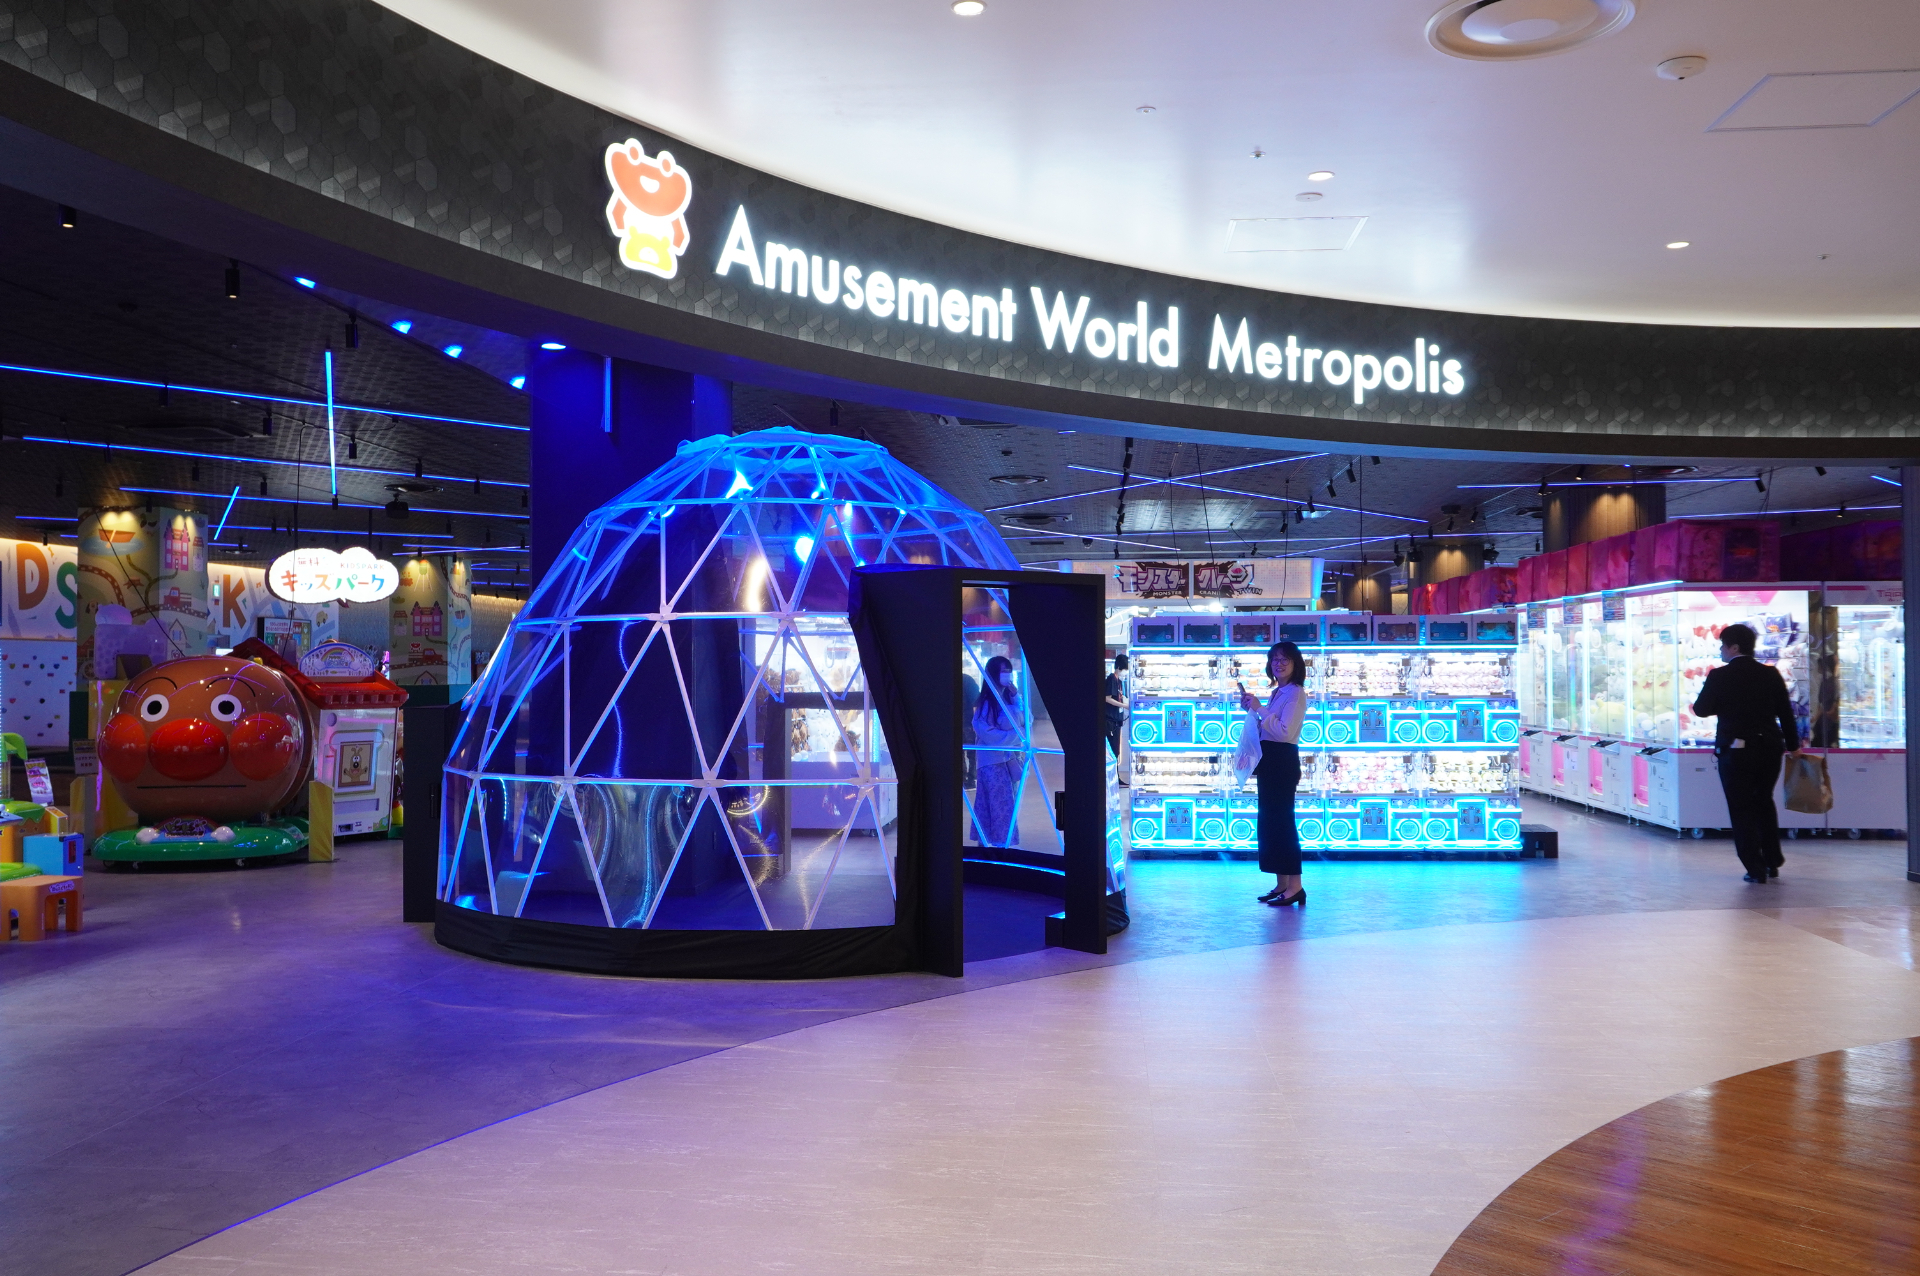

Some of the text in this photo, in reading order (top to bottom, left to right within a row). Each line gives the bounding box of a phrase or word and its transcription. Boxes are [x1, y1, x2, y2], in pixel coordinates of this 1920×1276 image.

[714, 203, 1466, 405] Amusement World Metropolis
[281, 570, 385, 592] キッズパーク
[1237, 587, 1263, 596] TWIN
